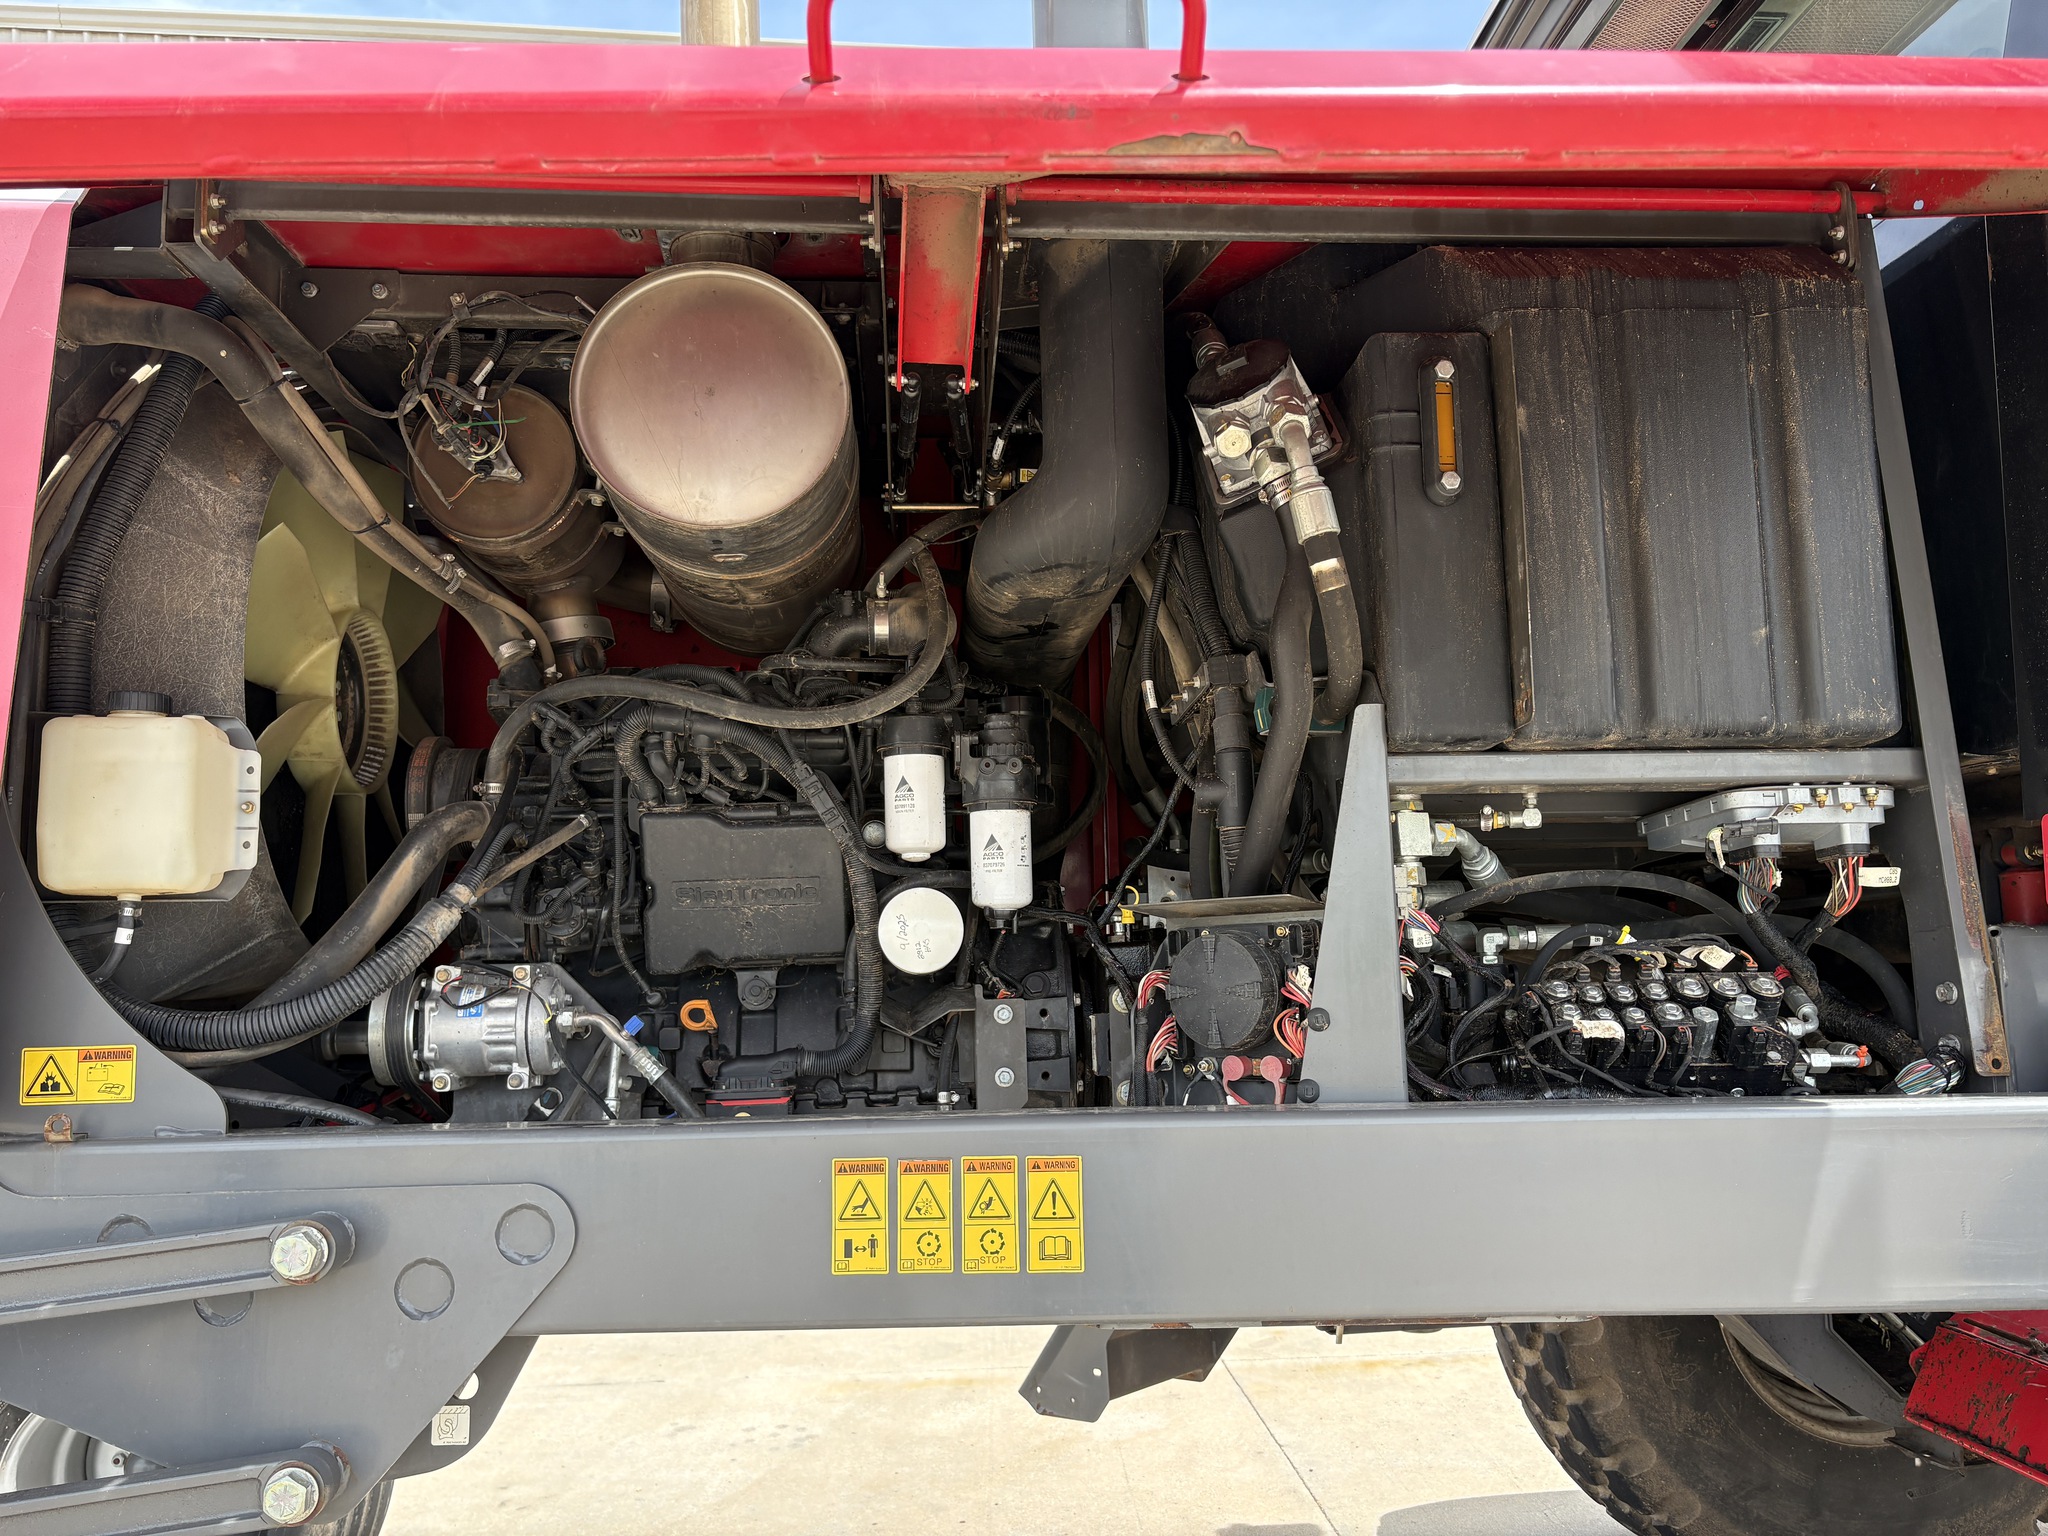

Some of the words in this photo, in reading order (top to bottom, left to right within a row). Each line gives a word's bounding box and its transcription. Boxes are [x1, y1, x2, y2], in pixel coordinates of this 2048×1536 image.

[674, 883, 819, 905] SisuTronic
[895, 913, 910, 950] 9/2025
[94, 1050, 132, 1060] WARNING
[295, 1106, 309, 1114] TYPE
[848, 1162, 885, 1173] WARNING
[913, 1162, 949, 1173] WARNING
[979, 1160, 1012, 1171] WARNING
[1043, 1160, 1076, 1170] WARNING
[916, 1257, 943, 1266] STOP
[980, 1255, 1006, 1265] STOP
